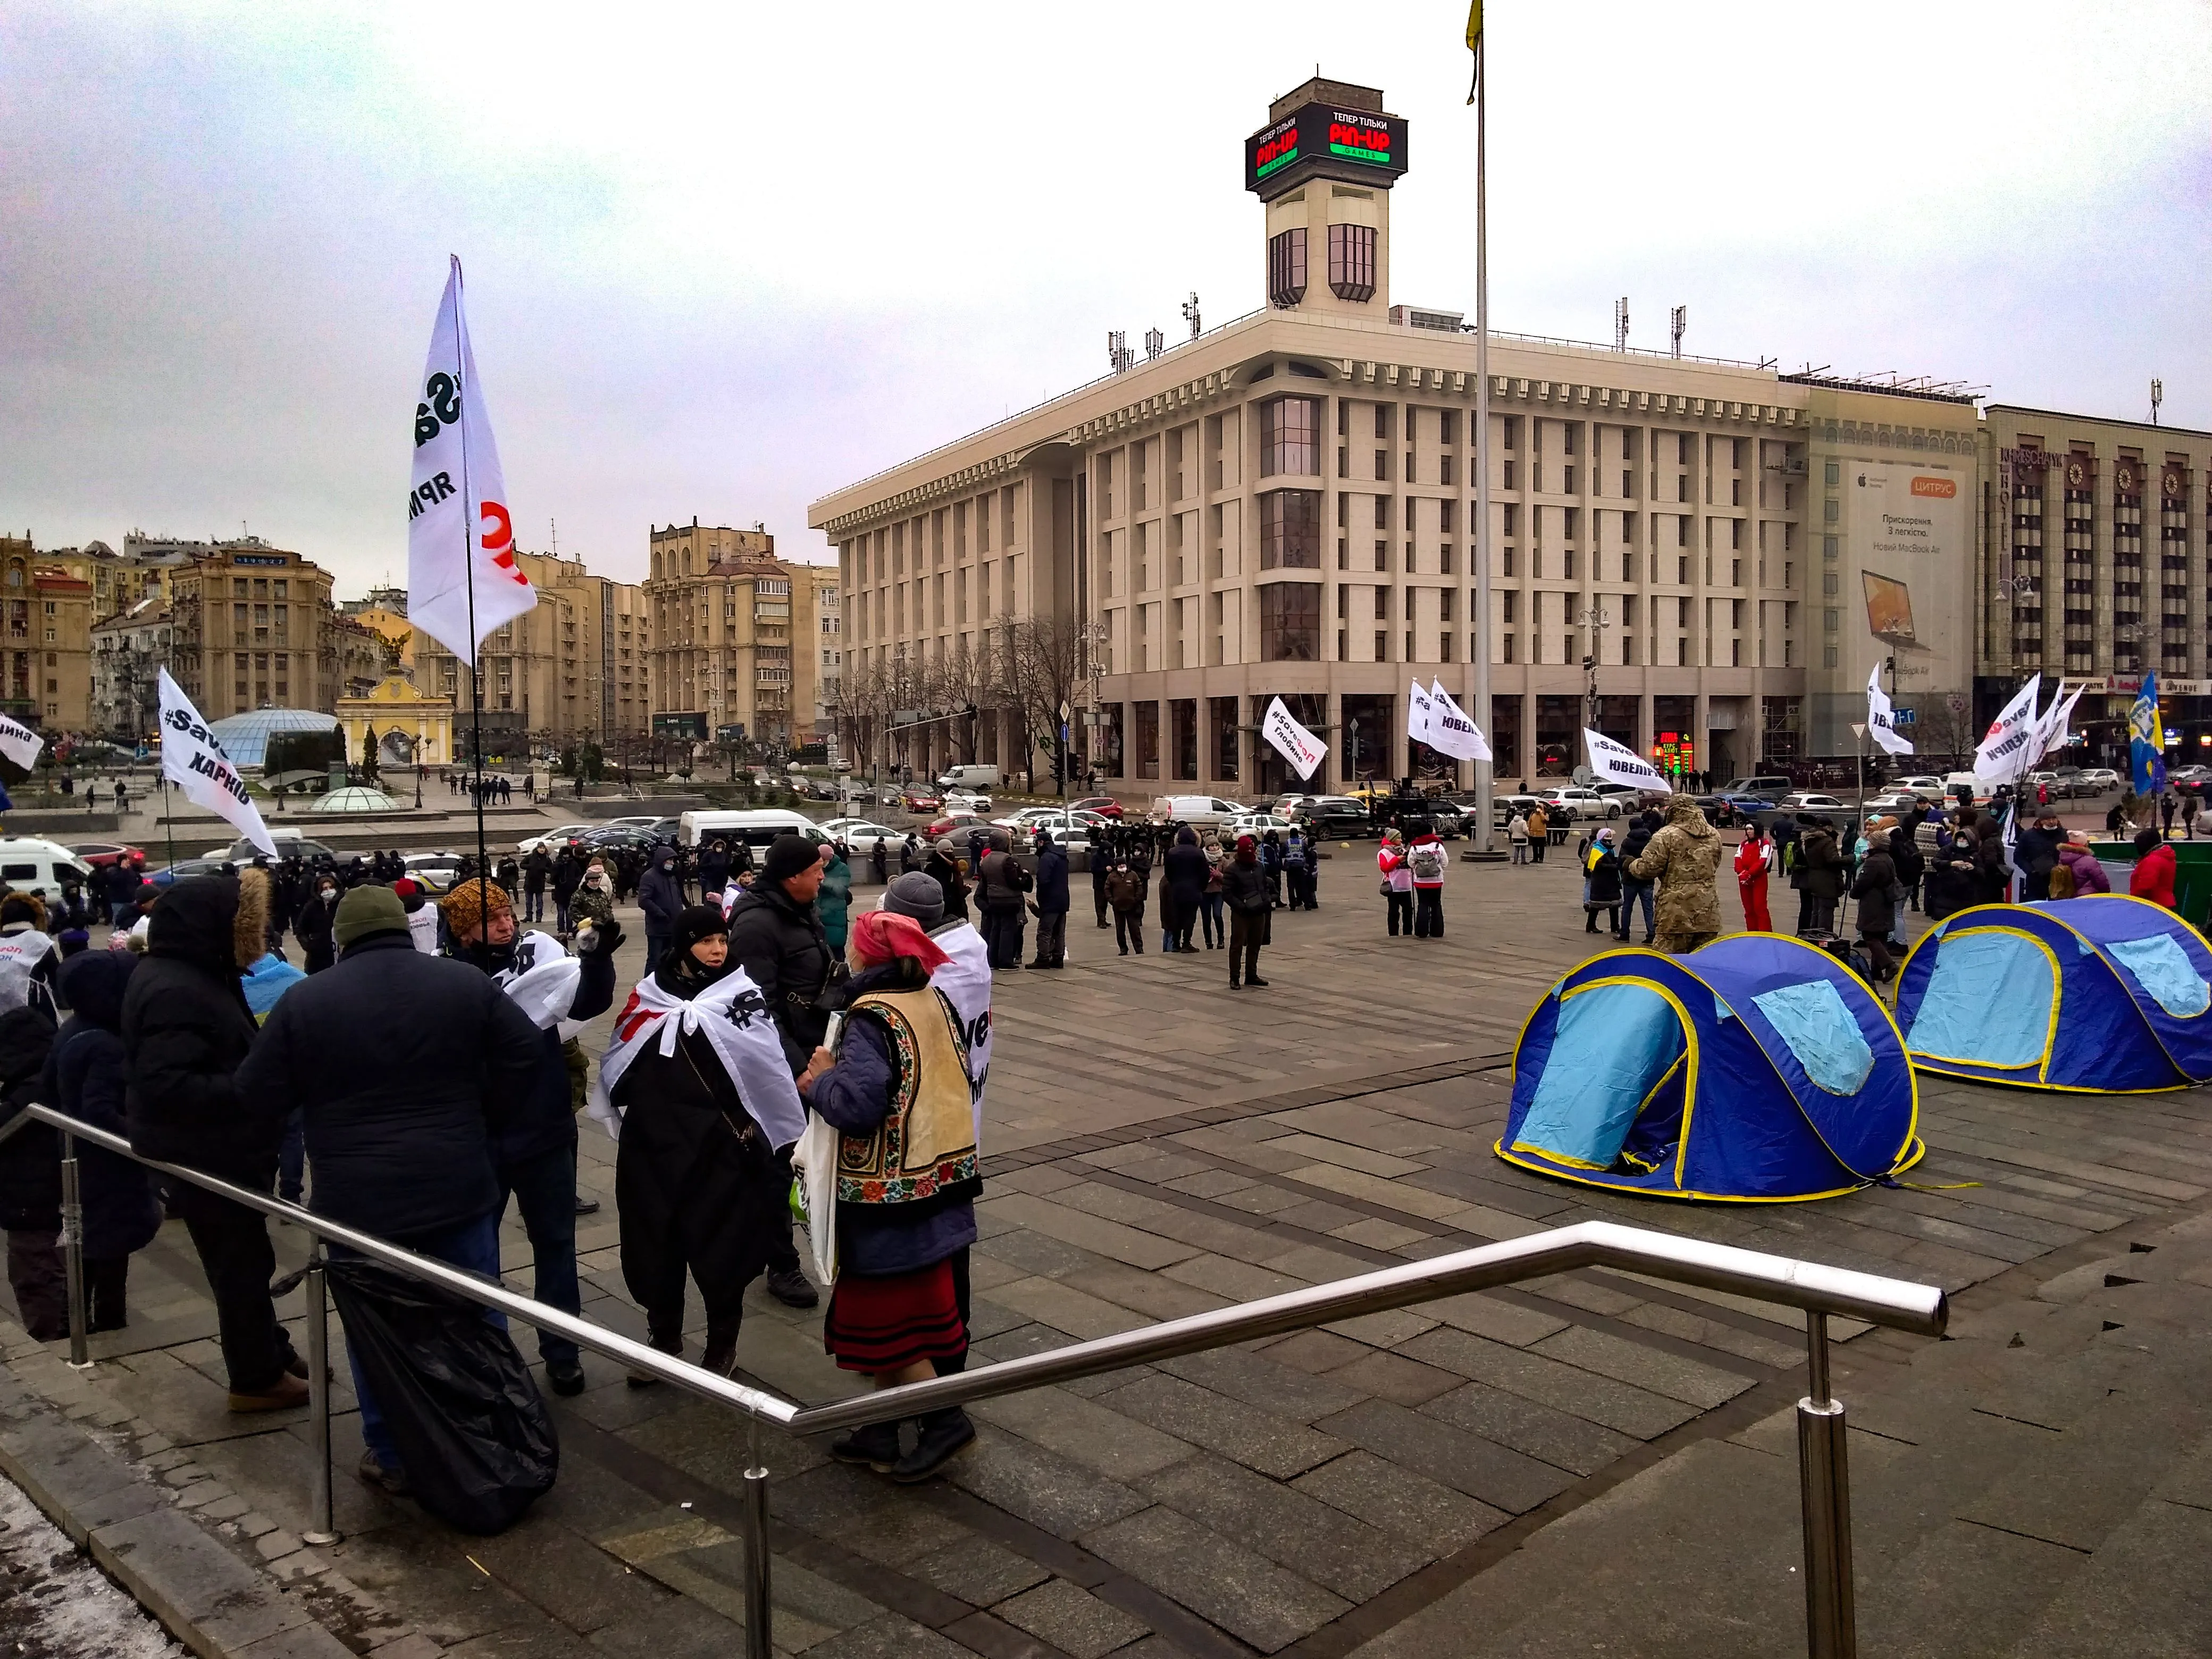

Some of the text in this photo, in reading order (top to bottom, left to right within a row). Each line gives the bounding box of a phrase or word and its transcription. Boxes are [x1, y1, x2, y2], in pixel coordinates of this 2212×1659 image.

[1333, 112, 1387, 130] ТЕПЕР ТІЛЬКИ
[1259, 117, 1296, 145] ТЕПЕР ТІЛЬКИ
[1915, 482, 1952, 494] ЦИТРУС
[1882, 514, 1933, 526] Прискорення.
[1873, 542, 1897, 552] Новий
[1898, 543, 1930, 554] MacBook
[1274, 726, 1303, 763] Глобине
